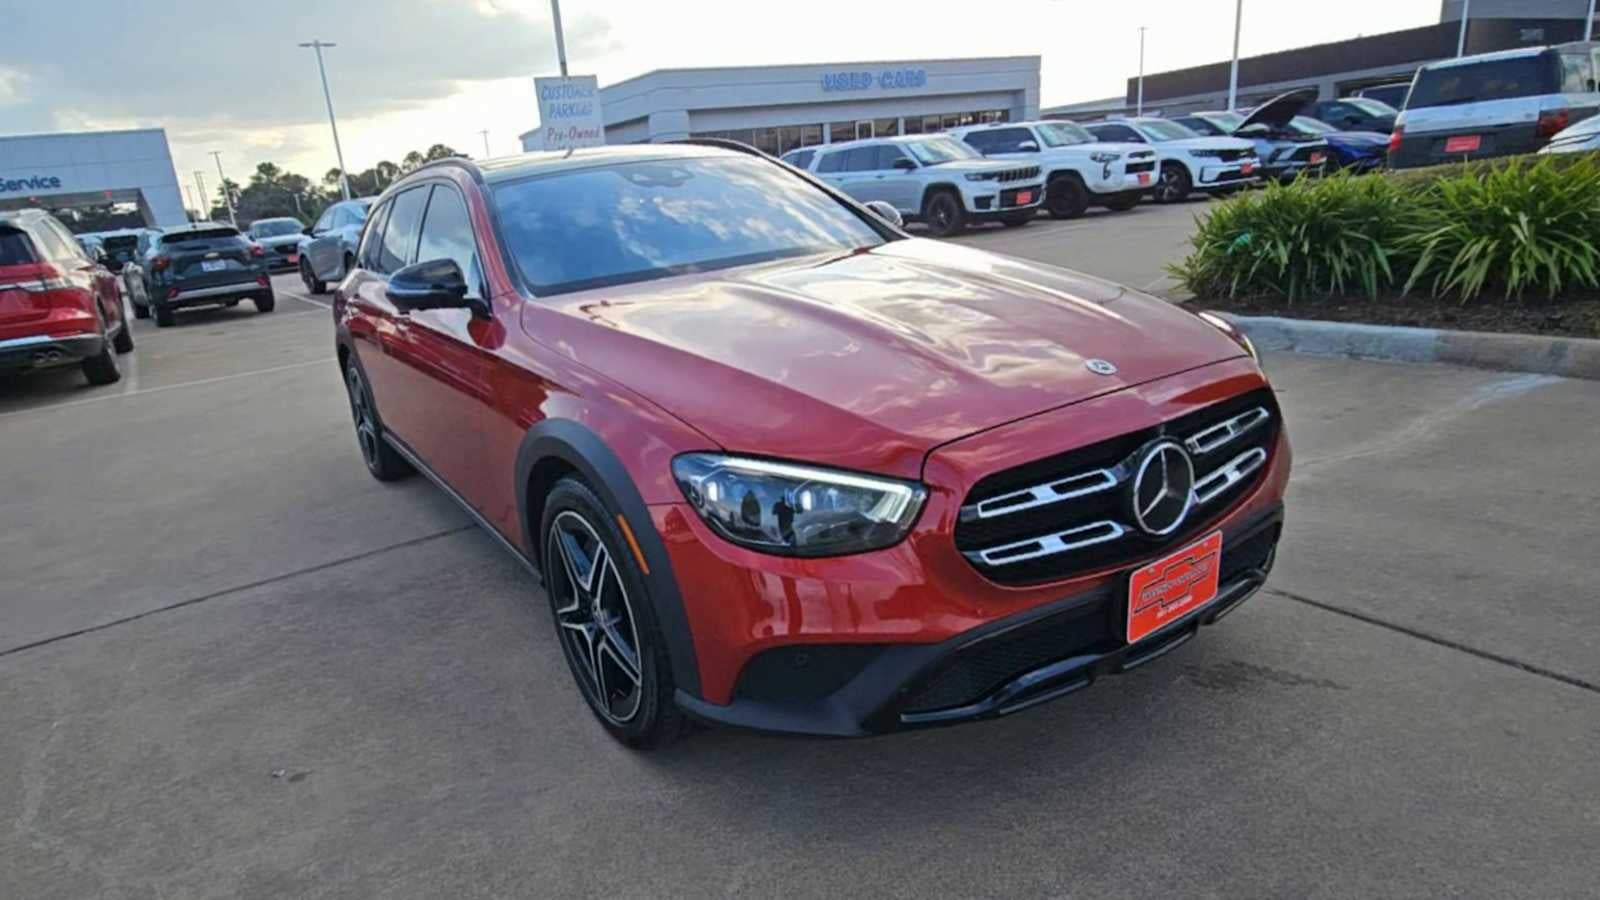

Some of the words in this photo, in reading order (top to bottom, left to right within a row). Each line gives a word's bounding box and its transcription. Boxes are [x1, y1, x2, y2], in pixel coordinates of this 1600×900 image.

[823, 72, 872, 91] USED
[880, 68, 927, 89] CARS
[547, 126, 600, 141] Pre-Owned
